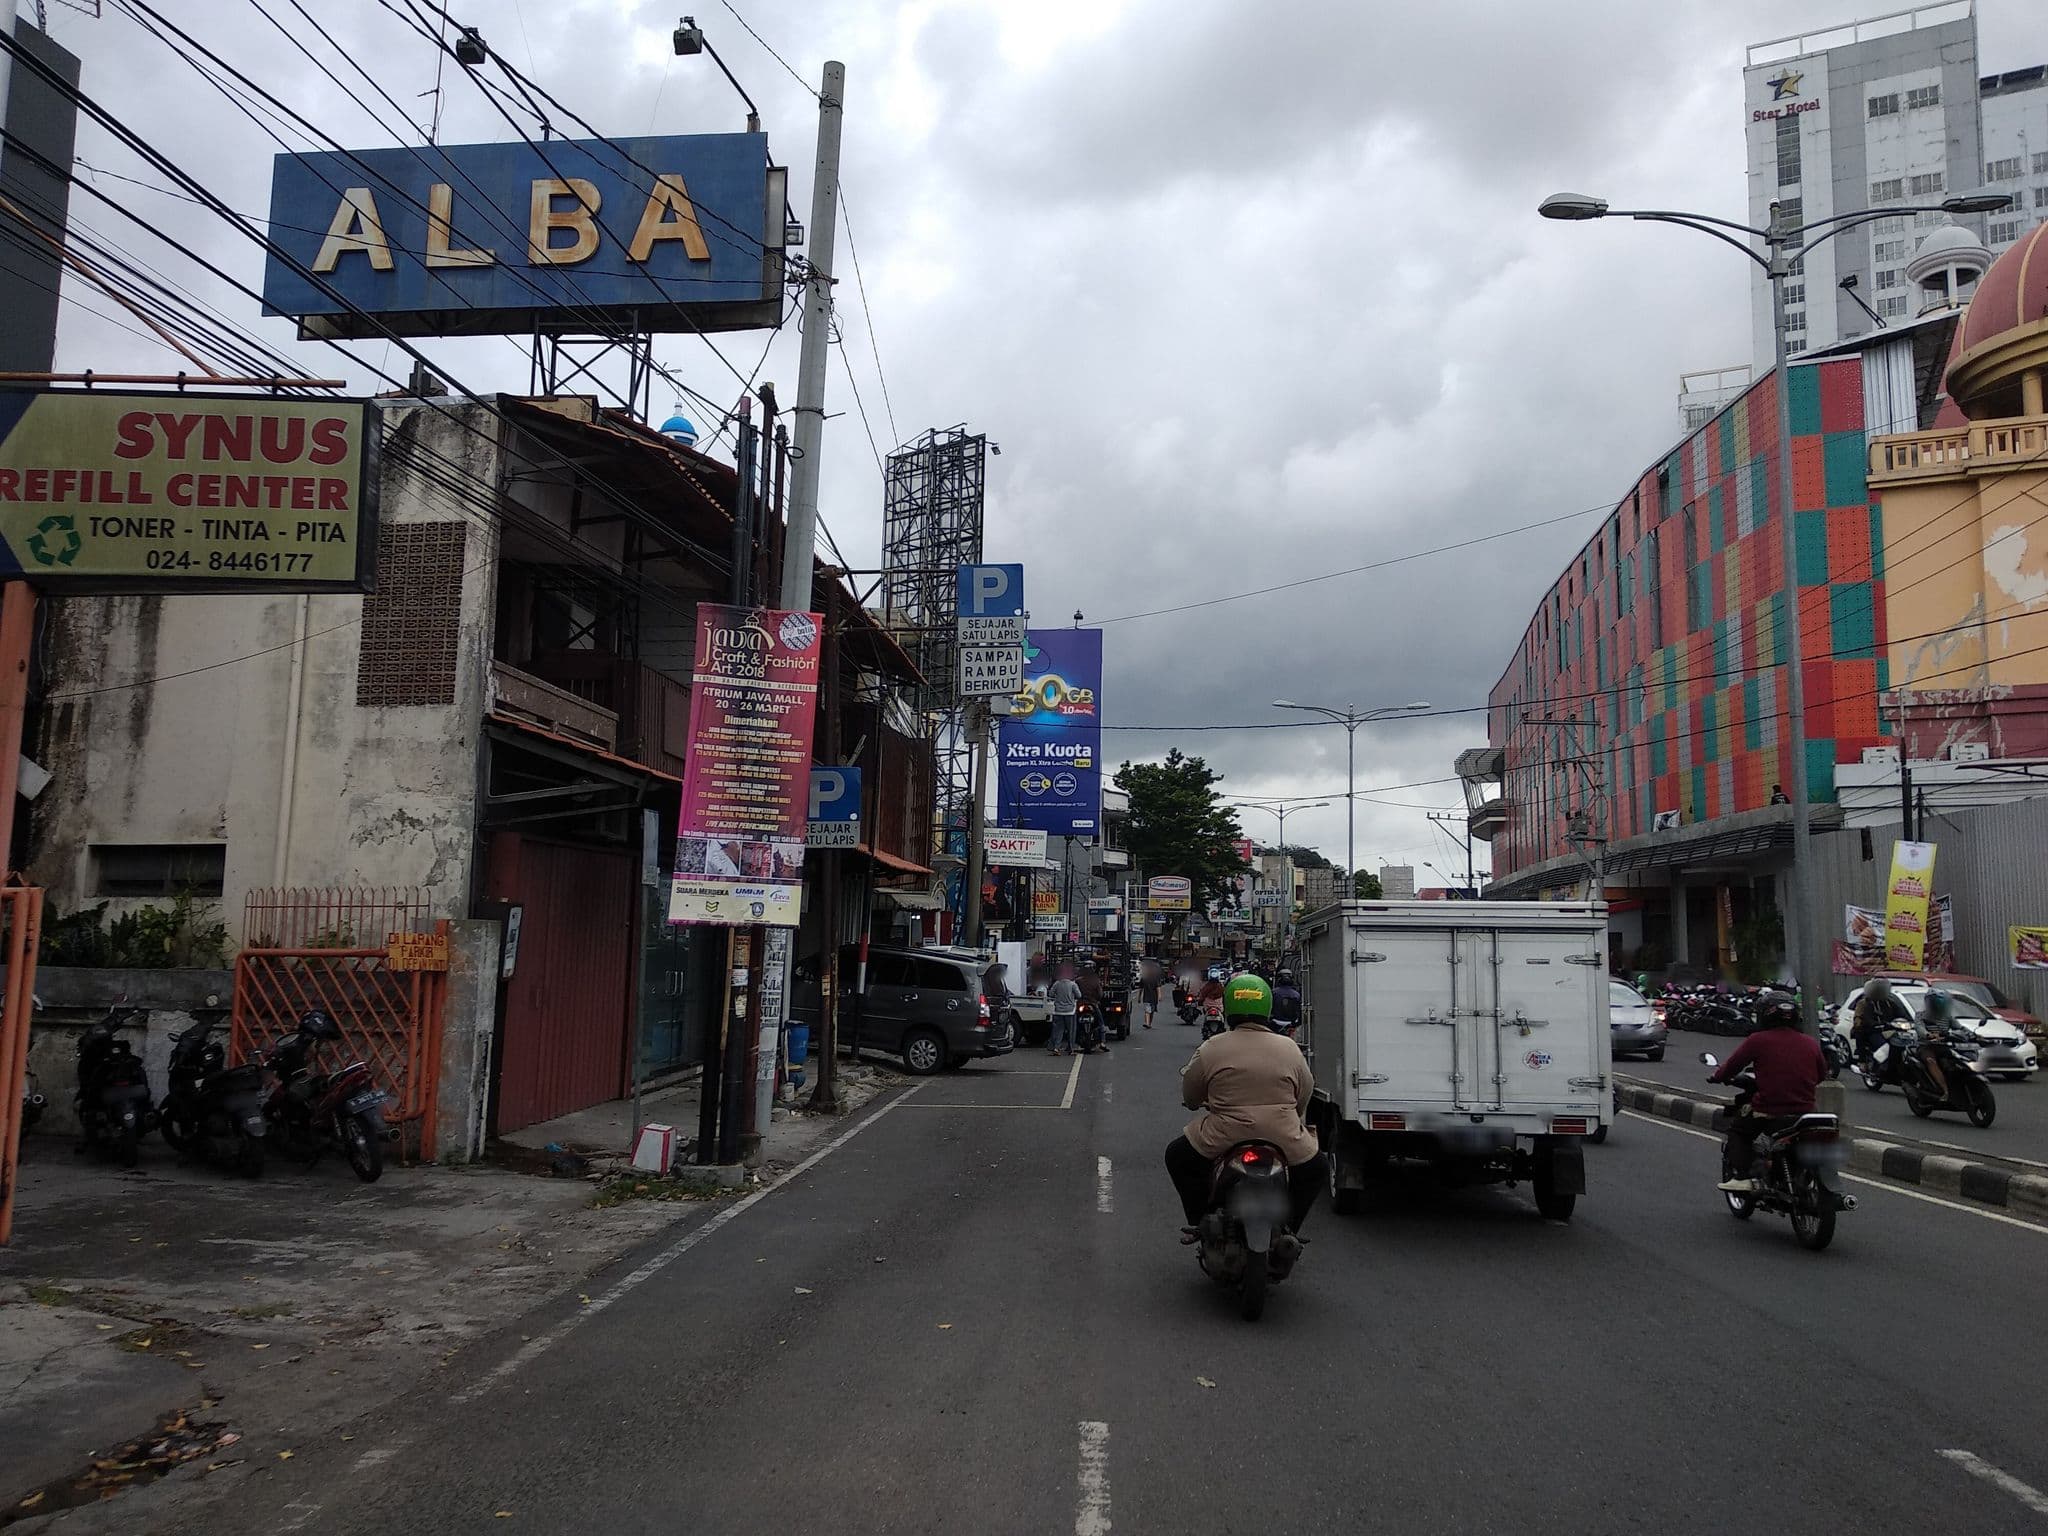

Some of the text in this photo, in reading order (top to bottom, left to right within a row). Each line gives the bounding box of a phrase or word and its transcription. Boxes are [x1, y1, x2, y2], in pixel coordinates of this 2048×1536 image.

[1753, 98, 1821, 122] Star Hotel
[311, 173, 711, 273] ALBA
[114, 411, 348, 465] SYNUS
[0, 468, 349, 511] REFILL CENTER
[89, 516, 175, 539] TONER
[202, 519, 270, 541] TINTA
[296, 521, 346, 543] PITA
[146, 550, 313, 572] 024- 8446177
[973, 567, 1008, 614] P
[968, 619, 1014, 629] SEJAJAR
[962, 630, 1019, 640] SATU LAPIS
[712, 648, 817, 670] Craft & Fashion
[965, 650, 1018, 662] SAMPAI
[710, 662, 766, 678] Art 2018
[965, 664, 1018, 678] RAMBU
[965, 678, 1017, 692] BERIKUT
[702, 686, 806, 706] ATRIUM JAVA MALL,
[715, 699, 729, 709] 20
[740, 702, 752, 711] 26
[755, 703, 791, 714] MARET
[1006, 743, 1092, 758] Xtra Kuota
[804, 835, 822, 845] ATU
[825, 835, 855, 845] LAPIS
